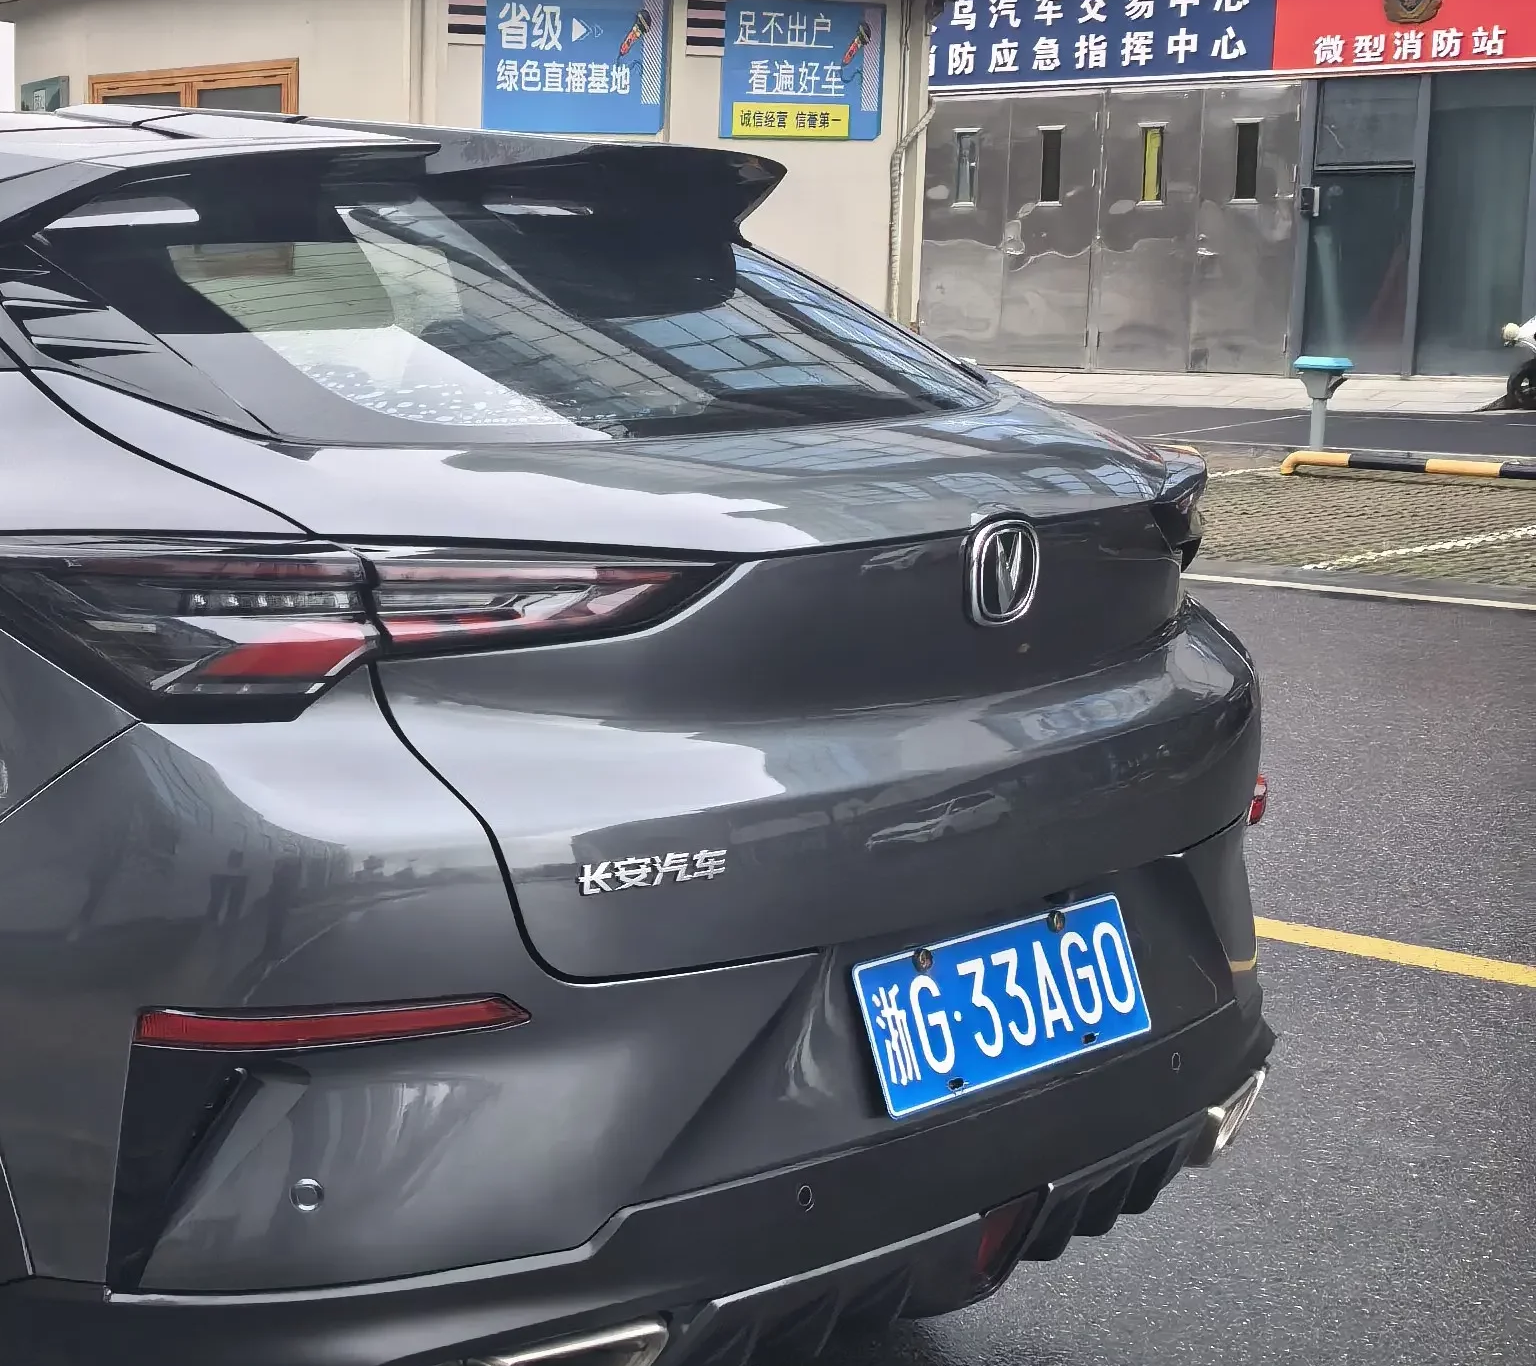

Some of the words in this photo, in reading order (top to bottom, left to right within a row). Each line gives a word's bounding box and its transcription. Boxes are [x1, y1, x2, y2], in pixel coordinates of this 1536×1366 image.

[497, 2, 562, 51] 省级
[734, 11, 832, 47] 足不出户
[1314, 25, 1507, 65] 微型消防站
[496, 58, 631, 95] 绿色直播基地
[747, 60, 845, 95] 看遍好车
[740, 109, 789, 129] 诚信经营
[577, 849, 728, 895] 长安汽车
